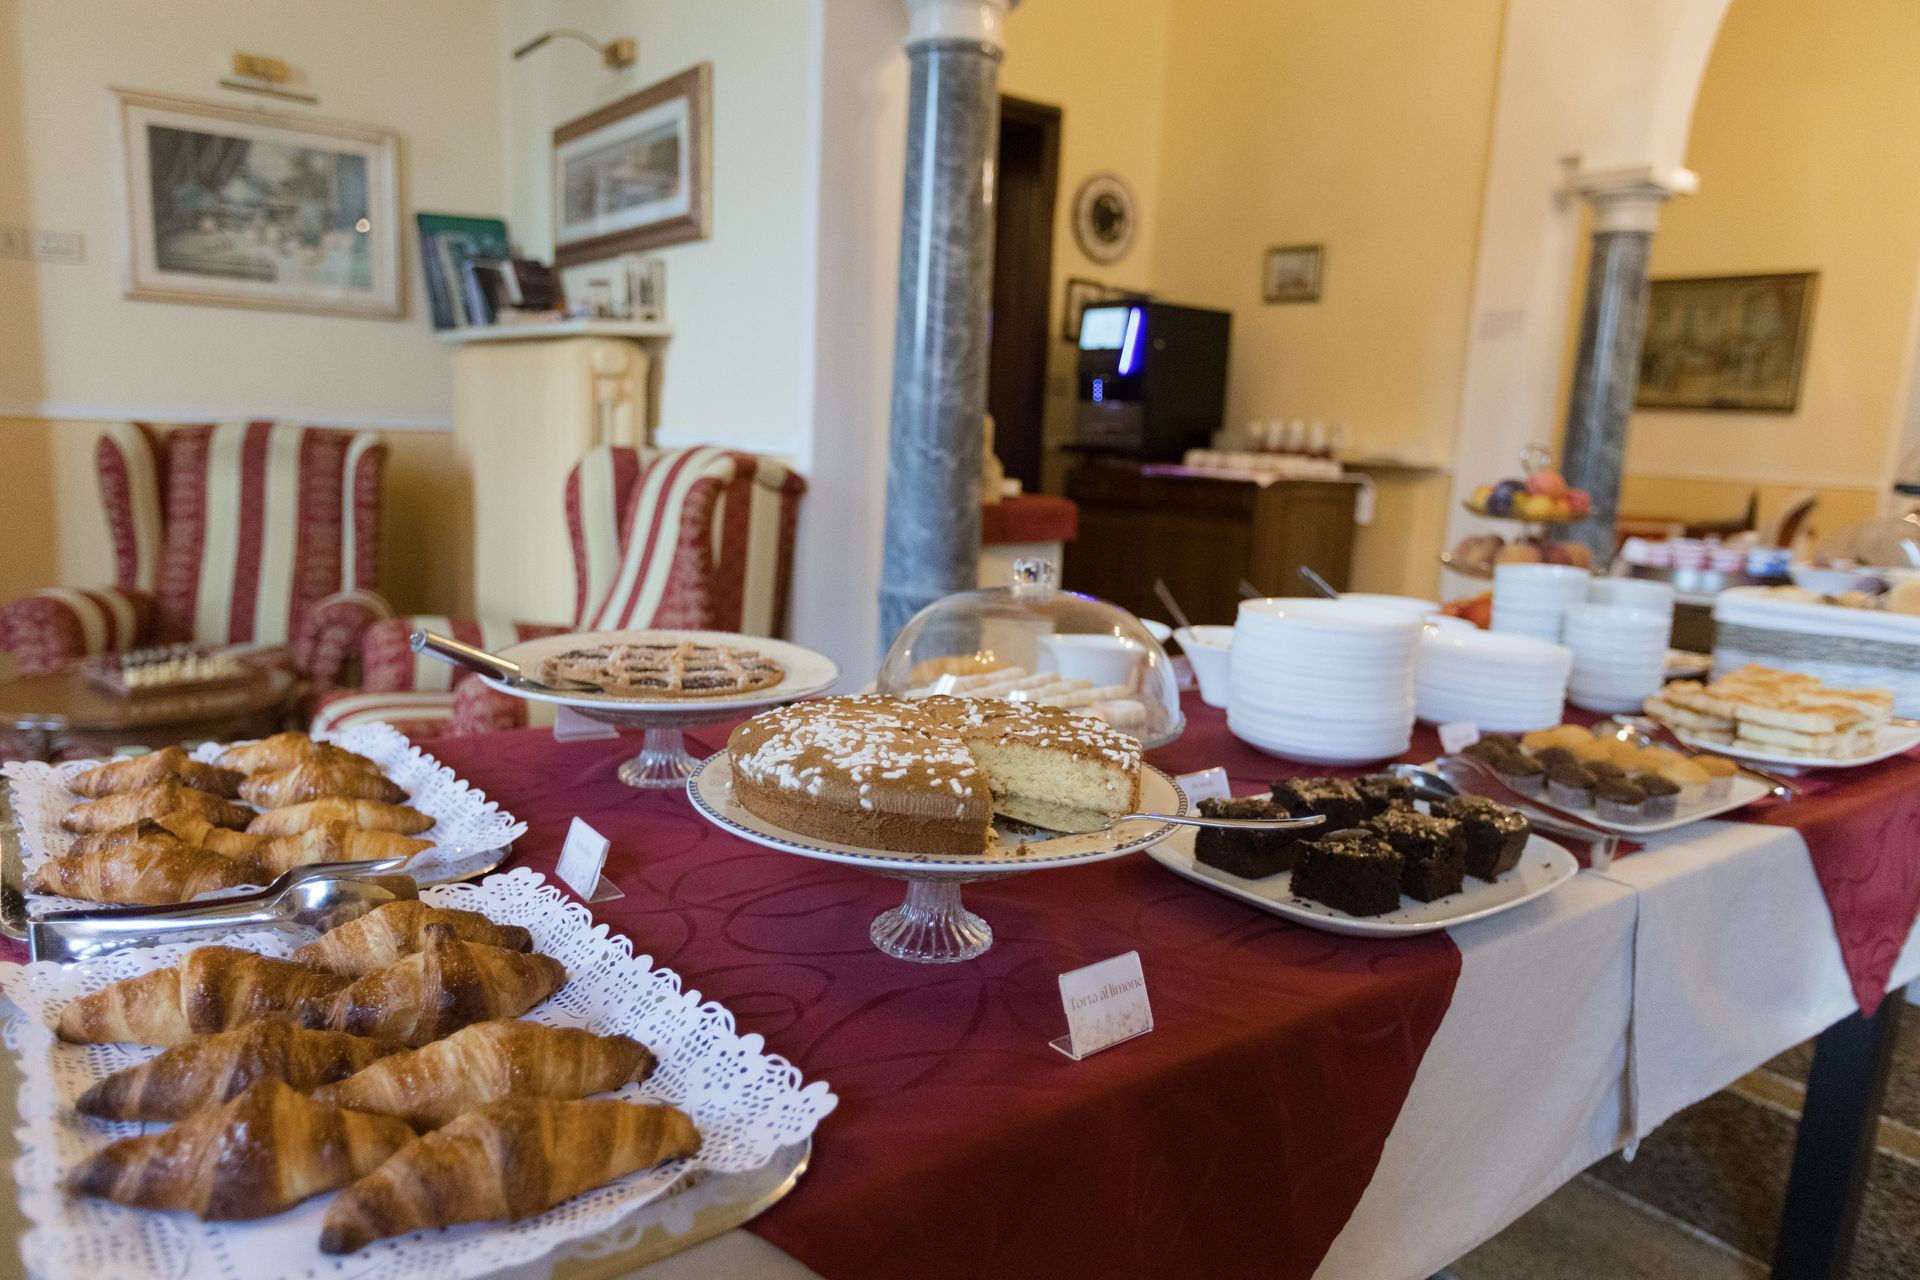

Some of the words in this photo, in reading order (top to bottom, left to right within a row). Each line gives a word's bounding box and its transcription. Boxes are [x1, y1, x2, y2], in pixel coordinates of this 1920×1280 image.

[1070, 992, 1098, 1011] Torta
[1100, 985, 1109, 1001] al
[1109, 977, 1143, 998] limone
